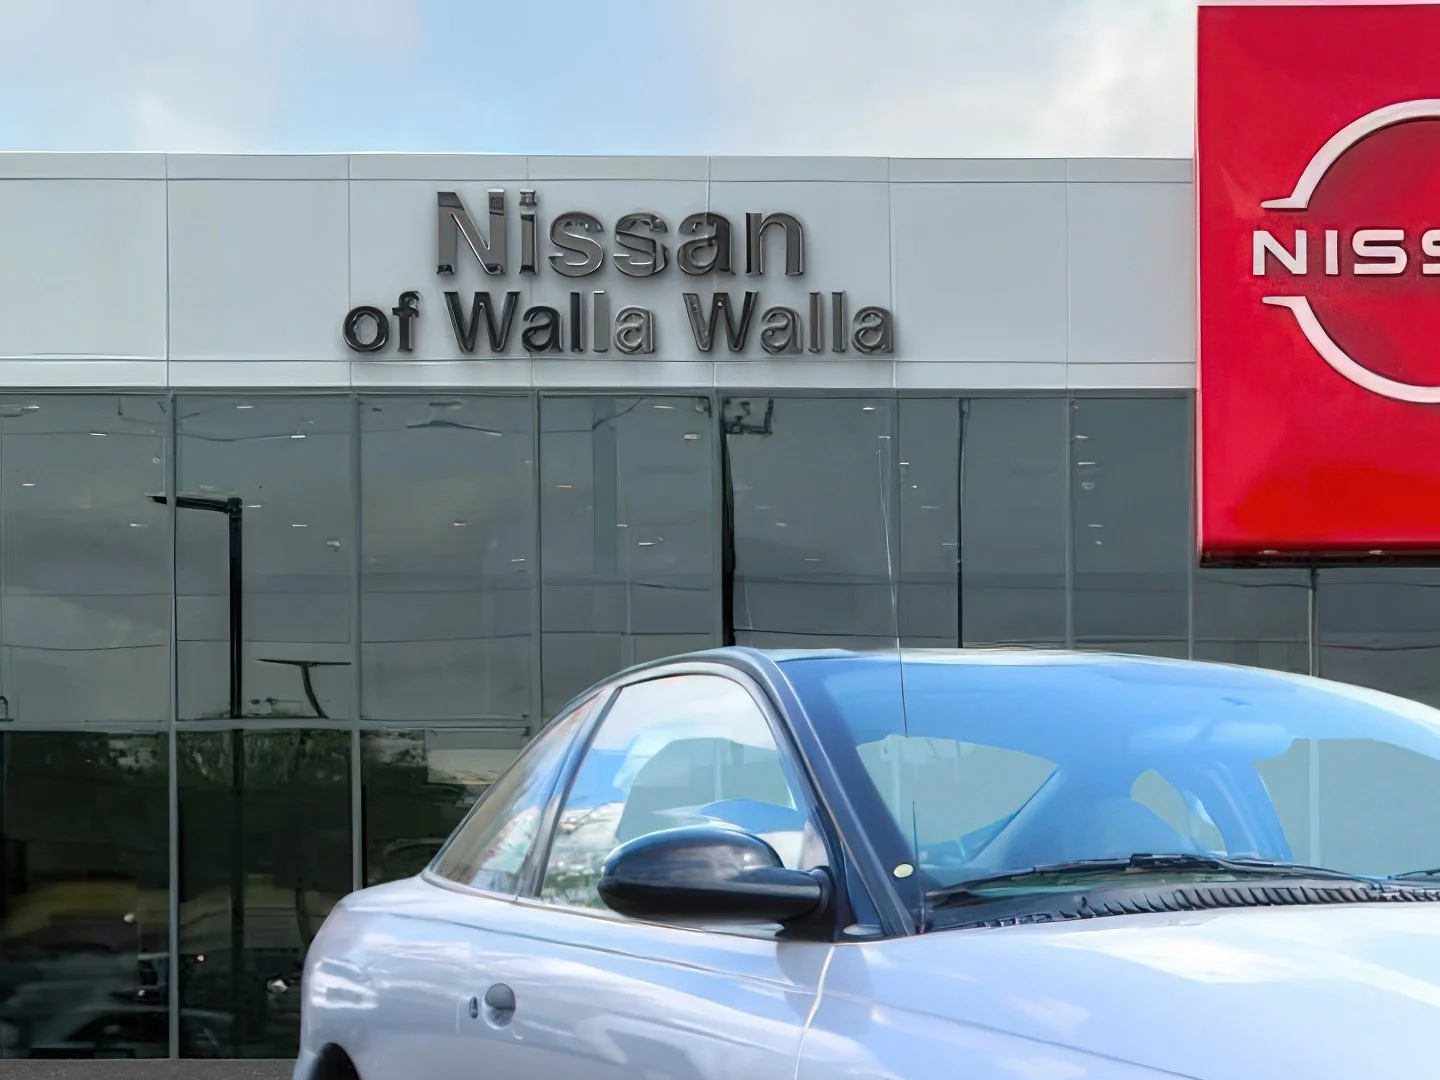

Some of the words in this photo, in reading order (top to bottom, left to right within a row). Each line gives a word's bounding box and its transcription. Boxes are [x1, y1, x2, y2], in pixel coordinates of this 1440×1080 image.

[436, 189, 807, 278] Nissan
[342, 291, 420, 353] of
[445, 290, 655, 354] Walla
[682, 290, 893, 354] Walla
